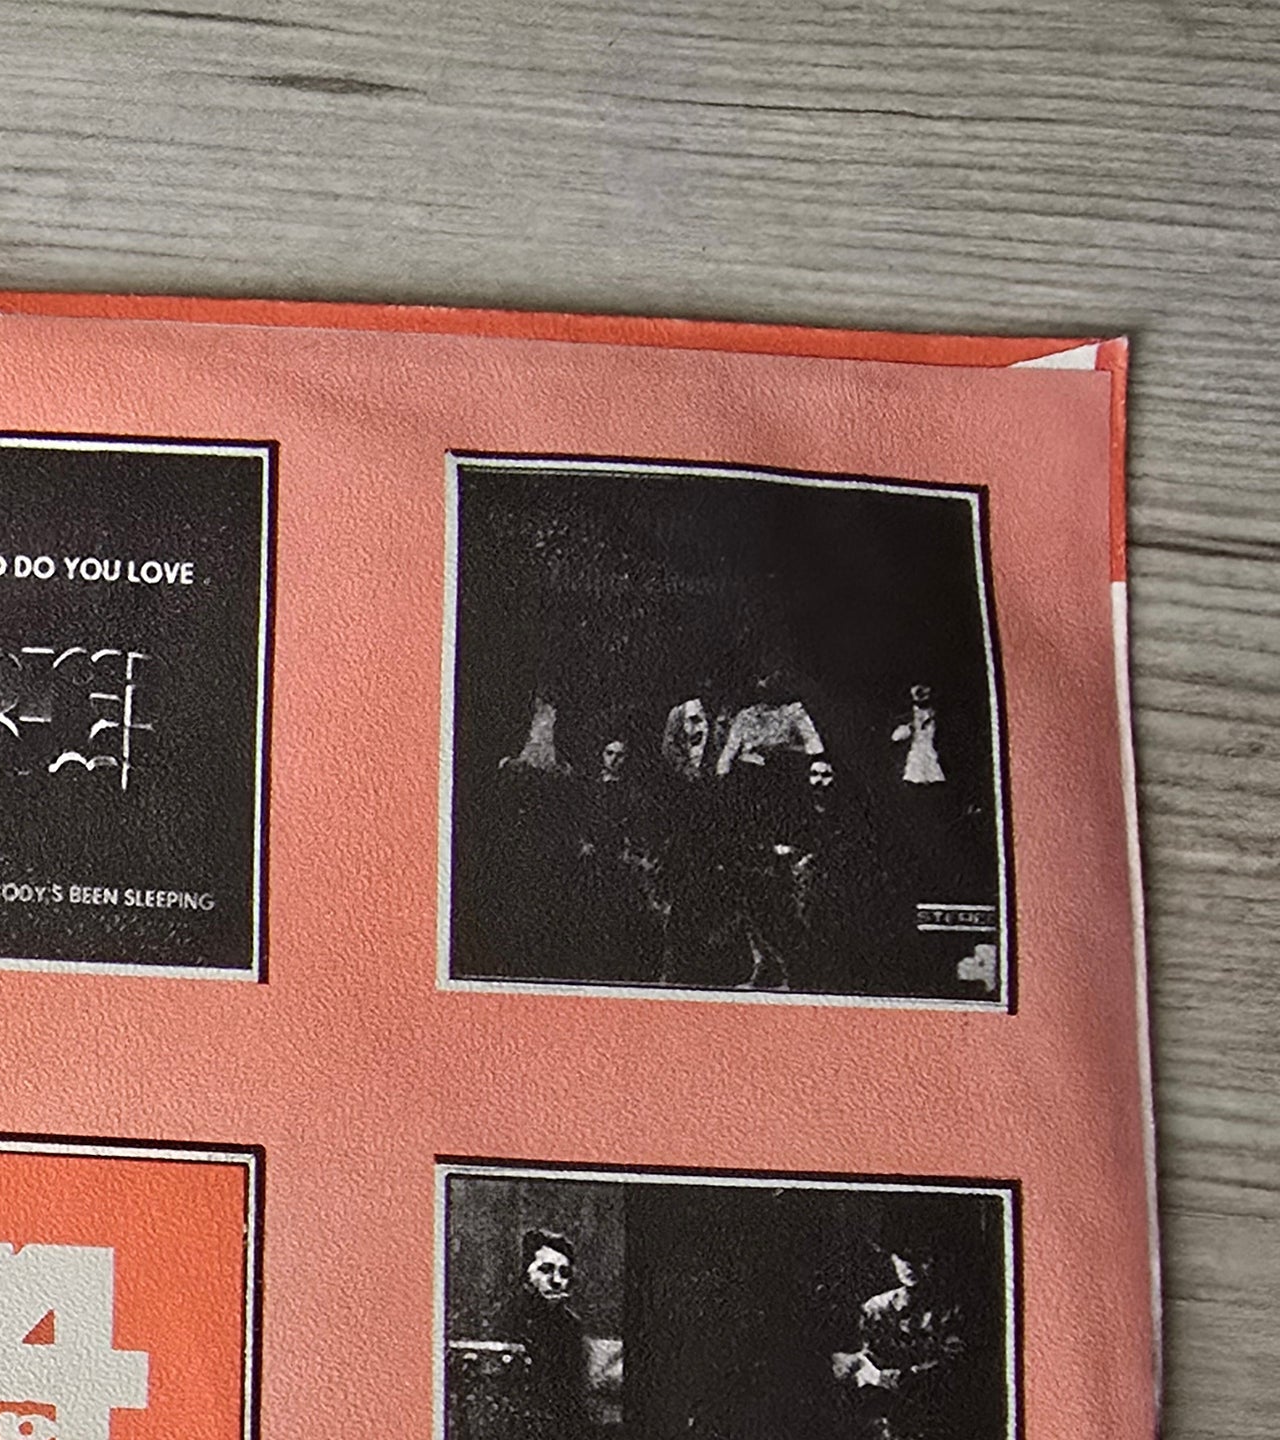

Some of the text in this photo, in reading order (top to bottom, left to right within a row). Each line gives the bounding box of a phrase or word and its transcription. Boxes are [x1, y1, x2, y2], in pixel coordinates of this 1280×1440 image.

[14, 555, 55, 580] DO
[63, 557, 121, 582] YOU
[127, 560, 195, 585] LOVE
[69, 886, 118, 906] BEEN
[123, 887, 215, 911] SLEEPING
